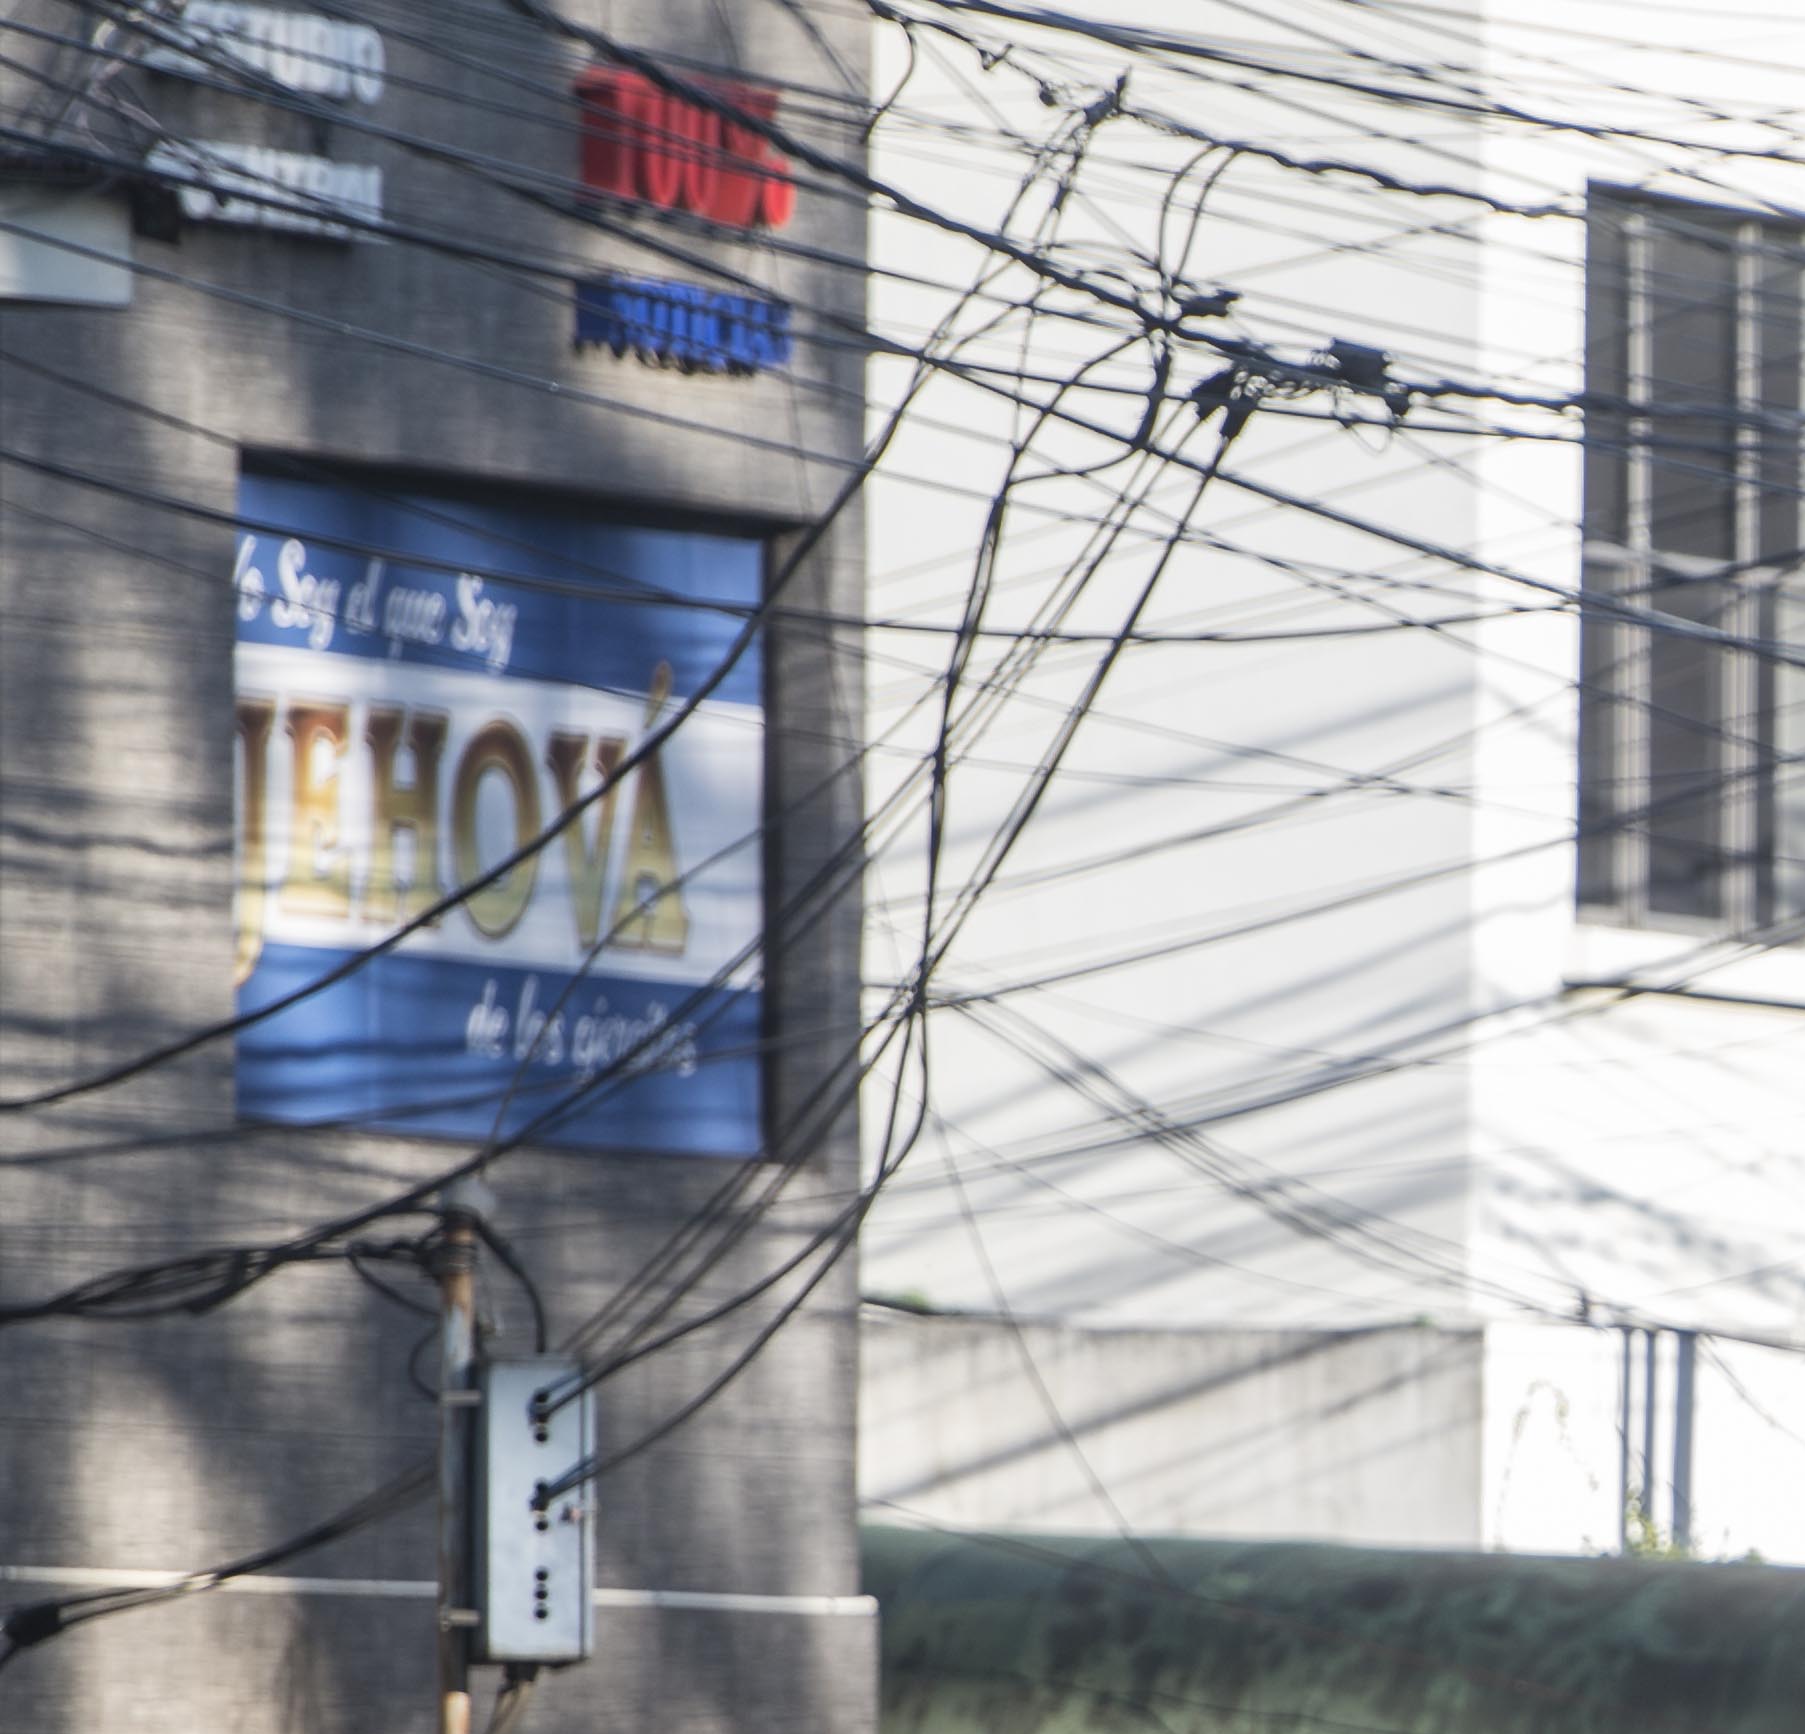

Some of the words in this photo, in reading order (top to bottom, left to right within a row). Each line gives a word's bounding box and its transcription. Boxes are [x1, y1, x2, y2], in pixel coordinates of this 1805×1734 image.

[270, 538, 342, 651] Soy
[344, 557, 386, 635] el
[451, 572, 518, 678] Soy
[466, 978, 510, 1060] de
